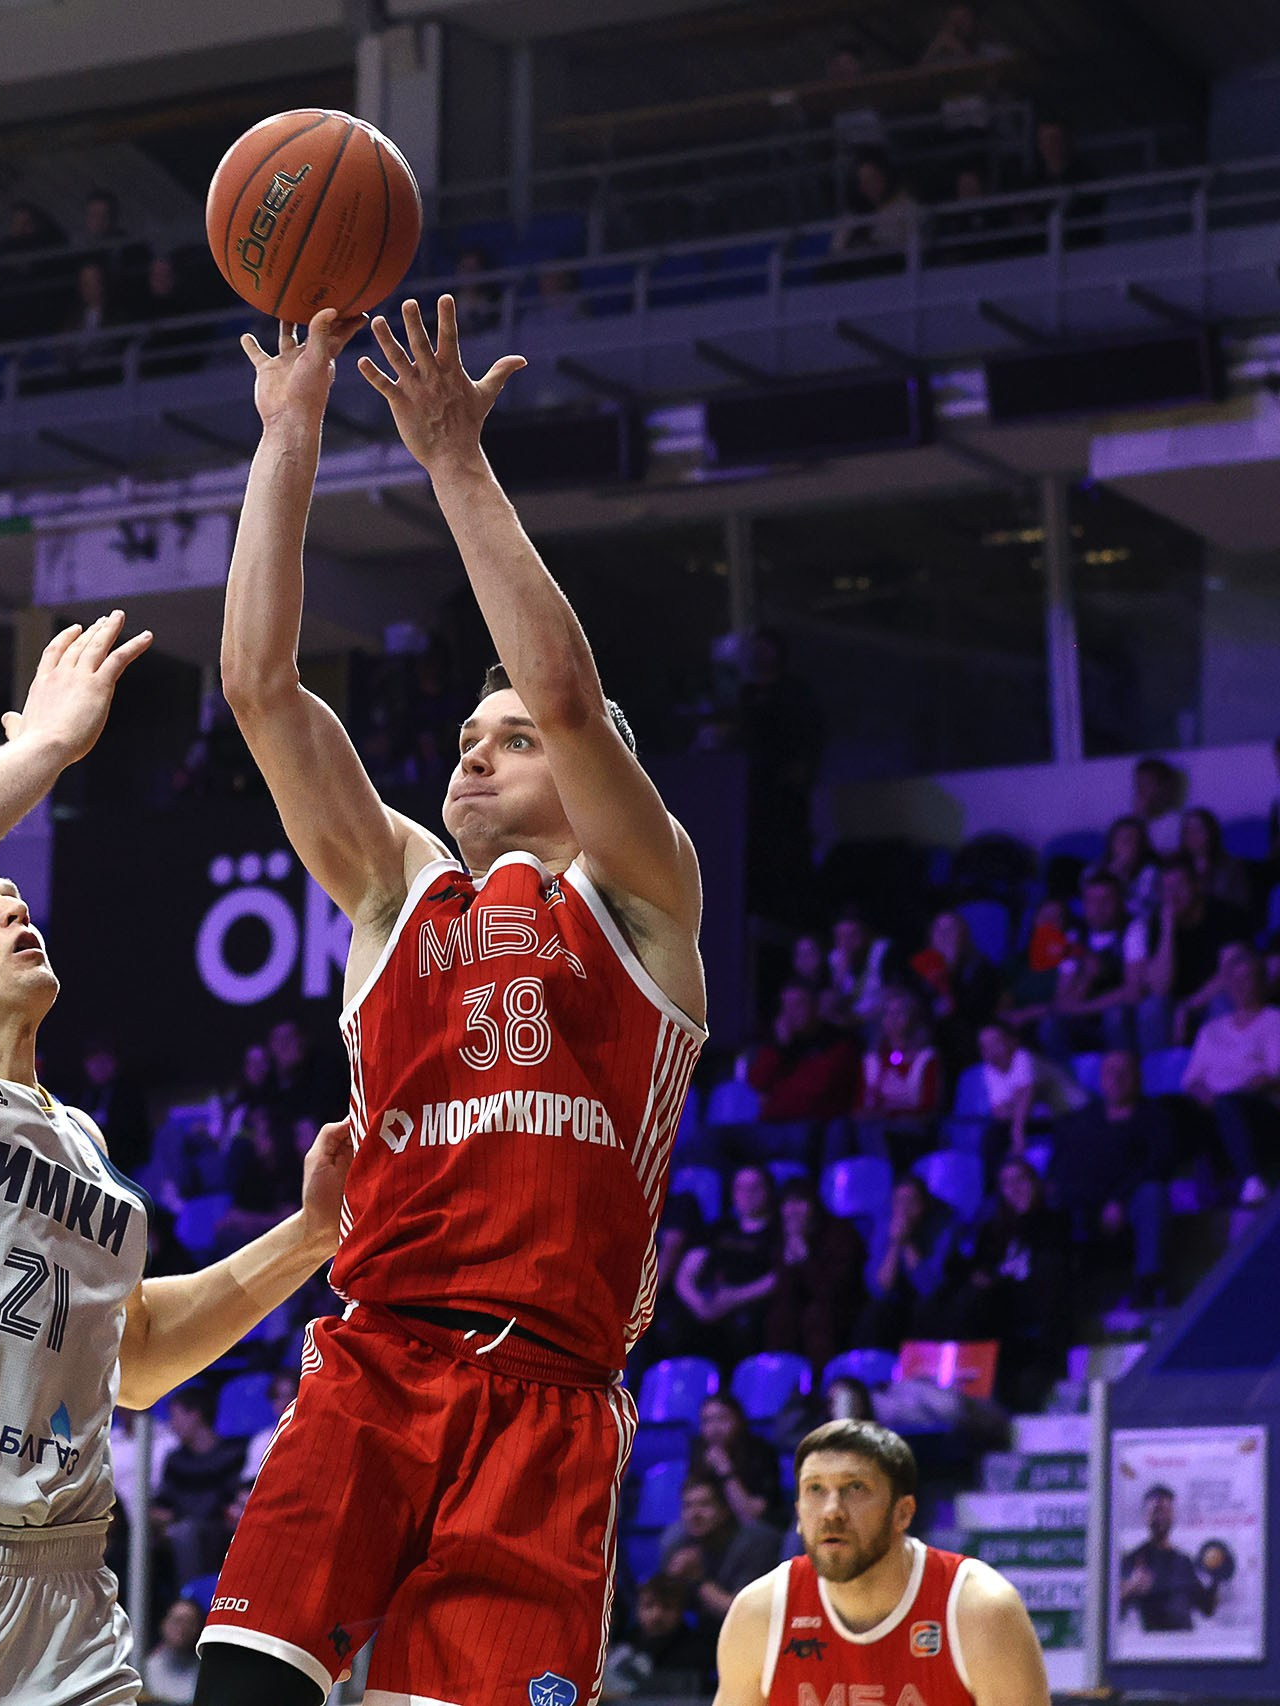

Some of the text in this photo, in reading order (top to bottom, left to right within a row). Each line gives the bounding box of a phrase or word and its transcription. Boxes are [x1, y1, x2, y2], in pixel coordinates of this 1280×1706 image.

[237, 163, 312, 291] JÖGEL
[459, 976, 552, 1071] 38
[419, 1089, 625, 1150] МОСИНЖПРОЕК
